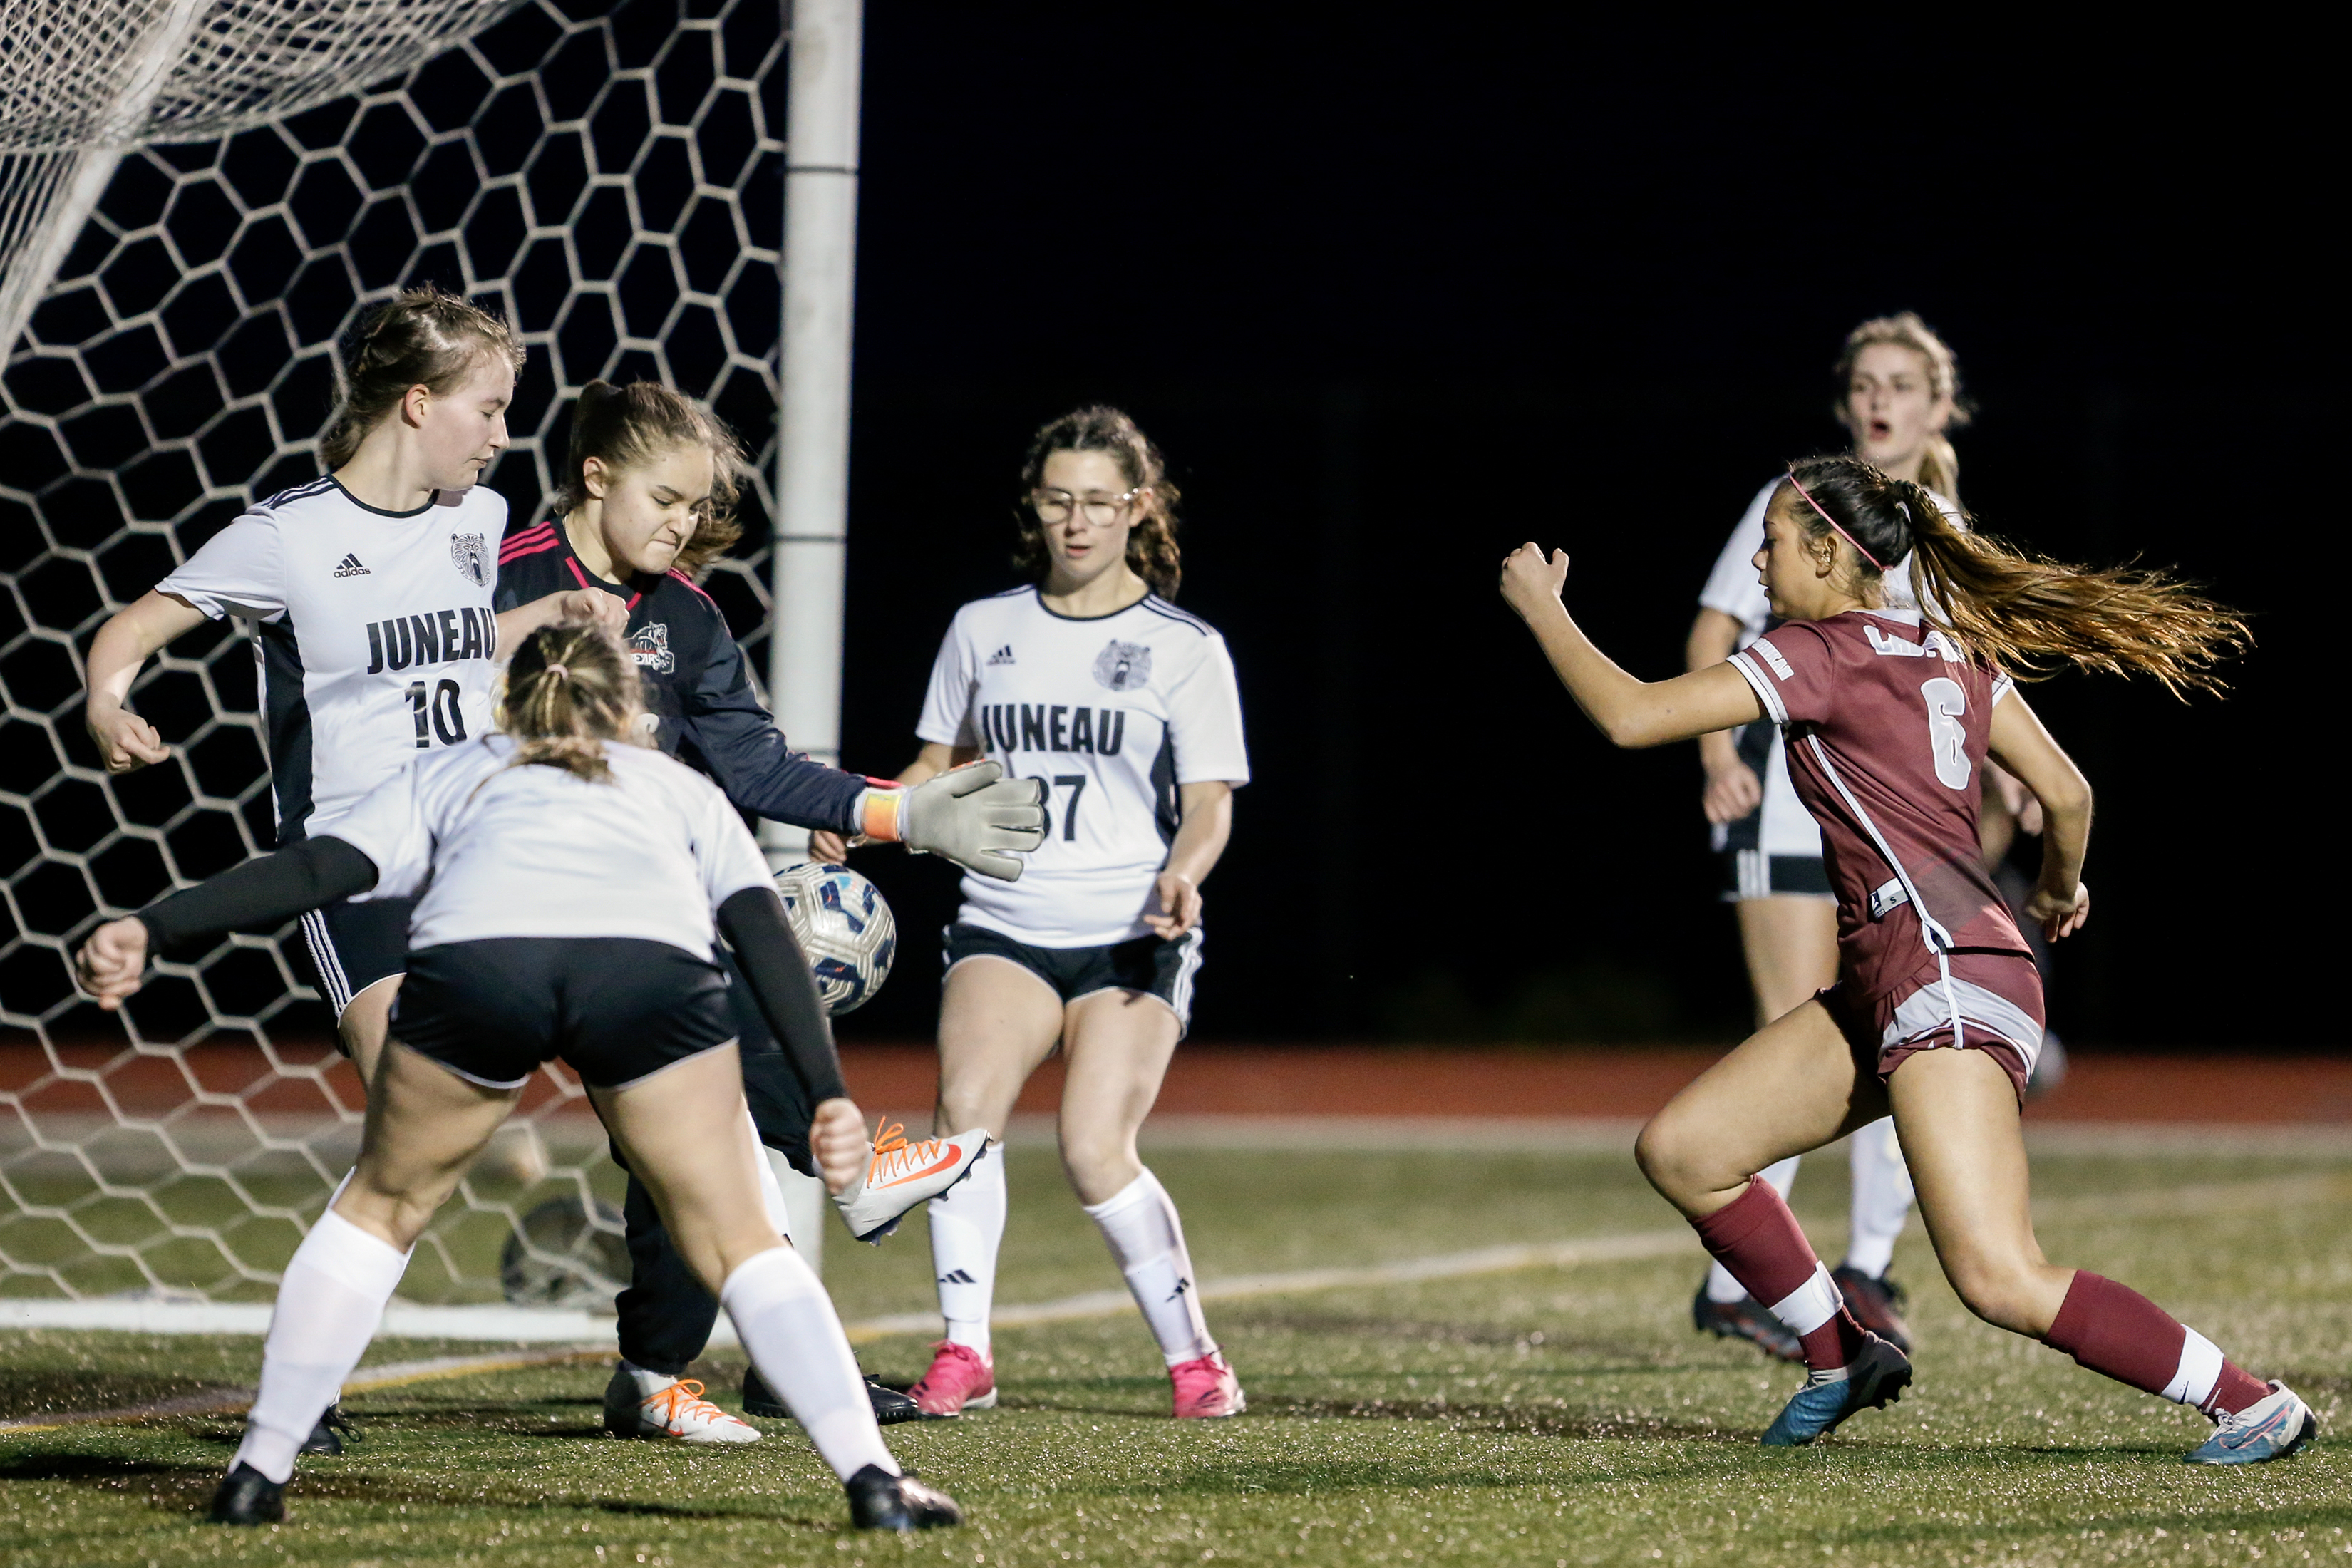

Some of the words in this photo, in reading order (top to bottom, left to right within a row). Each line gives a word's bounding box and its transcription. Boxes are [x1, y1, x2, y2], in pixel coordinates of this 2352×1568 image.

[333, 567, 371, 578] adidas
[366, 607, 496, 675] JUNEAU
[404, 679, 468, 748] 10
[983, 703, 1125, 756] JUNEAU
[1920, 677, 1972, 791] 6
